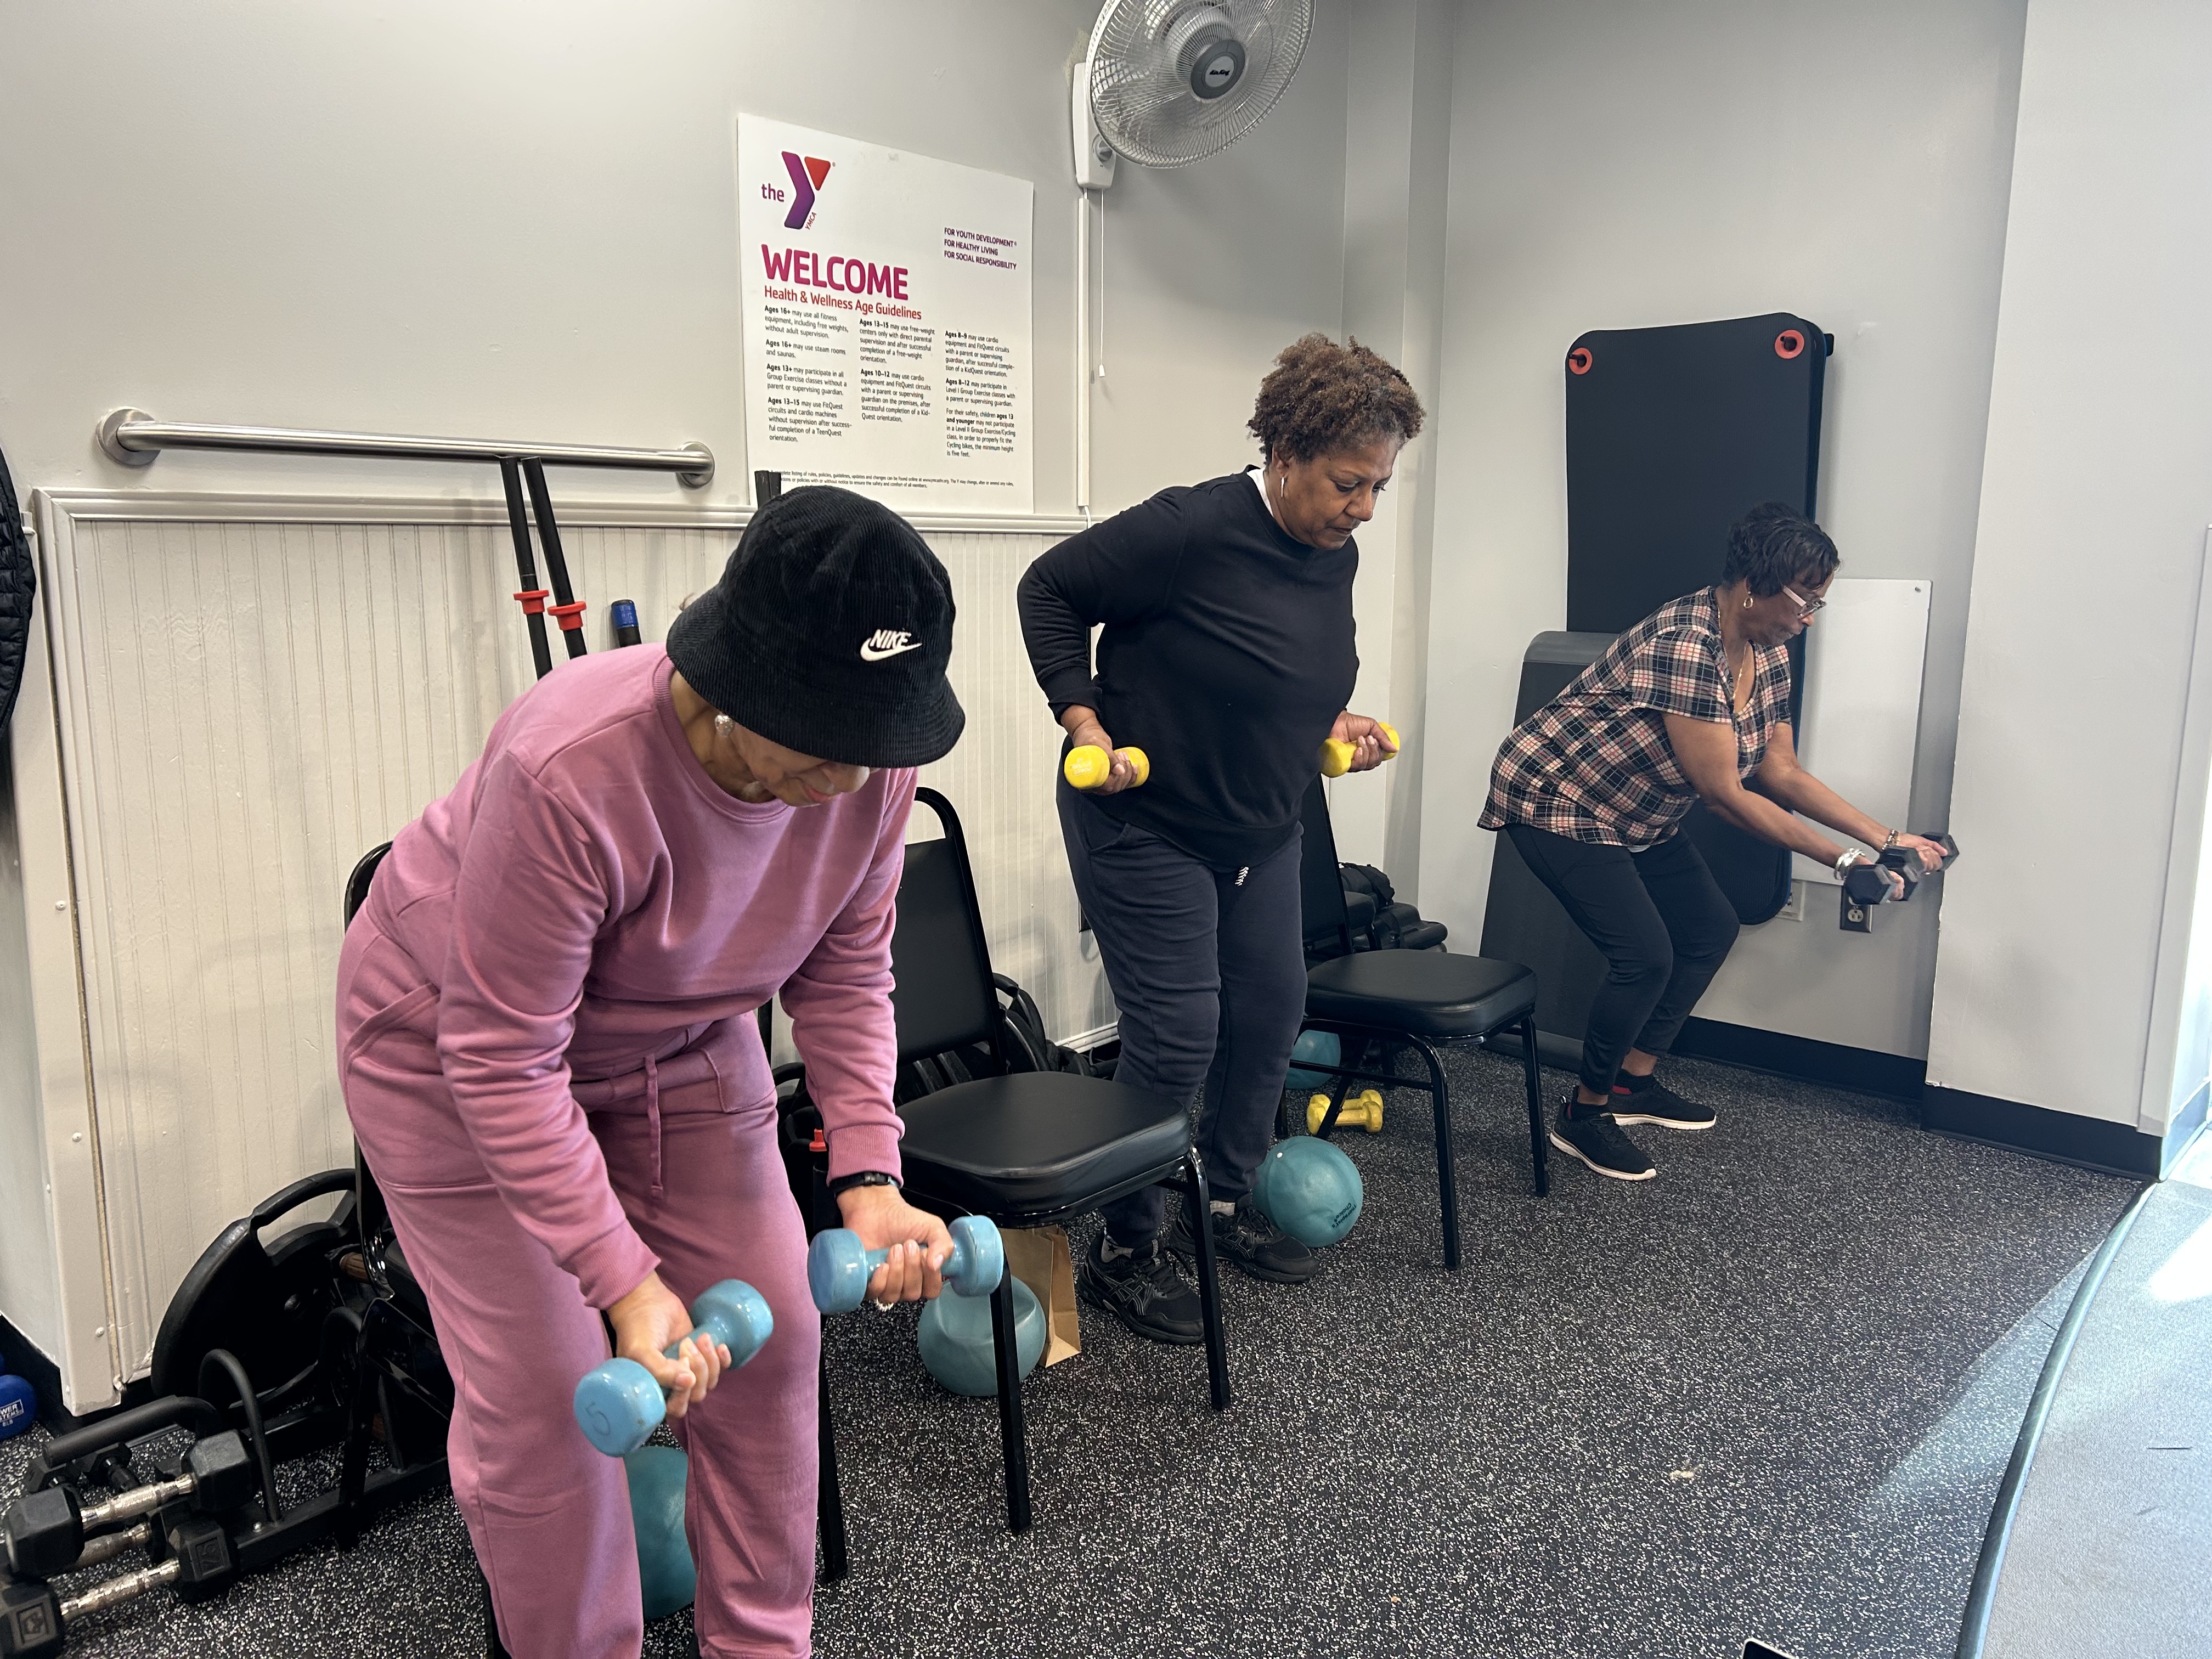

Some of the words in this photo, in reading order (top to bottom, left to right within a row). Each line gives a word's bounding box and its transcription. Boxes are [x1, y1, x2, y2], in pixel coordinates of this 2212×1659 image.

[761, 183, 785, 202] the
[781, 151, 831, 230] Y
[805, 212, 816, 230] YMCA
[944, 227, 955, 236] FOR
[956, 229, 975, 240] YOUTH
[944, 239, 955, 247] FOR
[956, 241, 980, 252] HEALTHY
[980, 245, 998, 256] LIVING
[944, 250, 955, 259] FOR
[956, 252, 974, 263] SOCIAL
[975, 256, 1017, 270] RESPONSIBILITY
[761, 244, 909, 301] WELCOME
[764, 285, 797, 302] Health
[800, 291, 808, 303] &
[810, 292, 853, 310] Wellness
[855, 298, 873, 315] Age
[876, 302, 922, 320] Guidelines
[764, 304, 778, 314] Ages
[792, 310, 802, 318] may
[820, 312, 837, 321] fitness
[765, 324, 785, 333] without
[794, 318, 816, 329] including
[817, 321, 827, 329] free
[859, 318, 872, 327] Ages
[909, 325, 935, 336] free-weight
[878, 330, 888, 338] only
[899, 332, 912, 341] direct
[945, 330, 957, 338] Ages
[765, 338, 780, 348] Ages
[860, 337, 886, 346] supervision
[860, 346, 885, 354] completion
[896, 349, 922, 360] free-weight
[766, 363, 781, 372] Ages
[805, 369, 831, 377] participate
[860, 368, 873, 377] Ages
[766, 372, 782, 382] Group
[783, 374, 804, 383] Exercise
[805, 376, 823, 385] classes
[823, 379, 843, 387] without
[895, 380, 914, 390] FitQuest
[945, 377, 957, 386] Ages
[980, 382, 1002, 391] participate
[792, 385, 820, 395] supervising
[899, 391, 924, 400] supervising
[768, 396, 782, 405] Ages
[822, 401, 843, 410] FitQuest
[768, 406, 786, 414] circuits
[816, 427, 842, 437] TeenQuest
[870, 629, 911, 649] NIKE
[0, 1403, 18, 1415] WER
[0, 1408, 19, 1421] STEMS
[585, 1400, 611, 1436] 5
